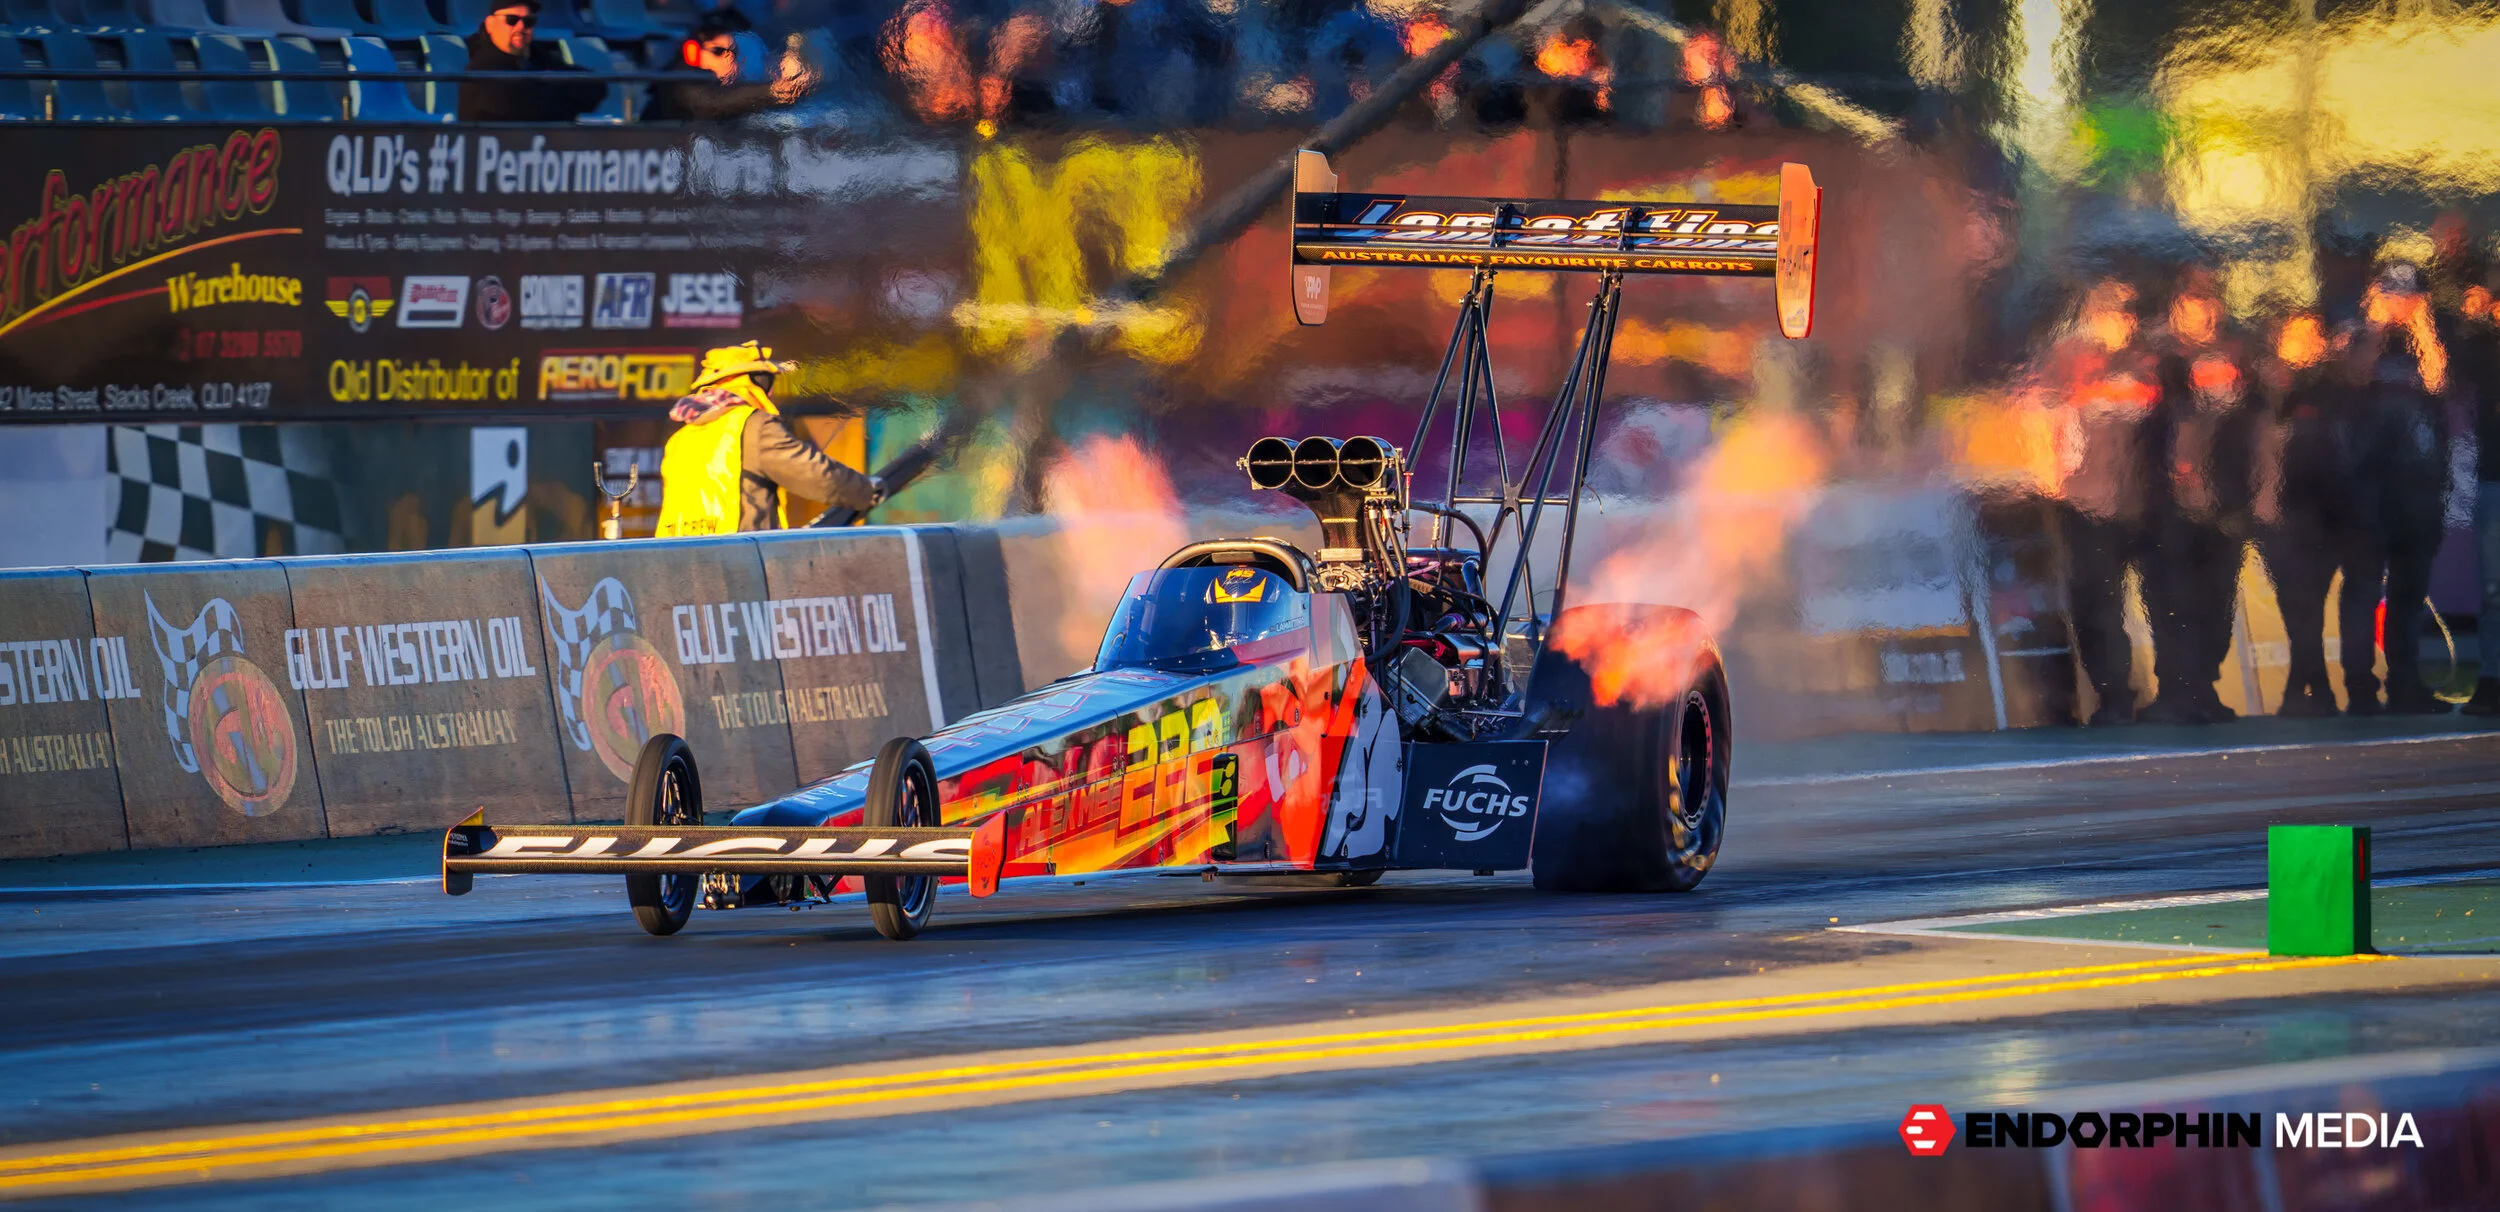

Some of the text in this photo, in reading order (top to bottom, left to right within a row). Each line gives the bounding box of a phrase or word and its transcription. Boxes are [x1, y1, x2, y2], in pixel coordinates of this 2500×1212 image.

[327, 134, 420, 196] QLD's
[428, 134, 465, 194] #1
[476, 134, 682, 194] Performance
[1322, 251, 1754, 272] AUSTRALIA'S FAVOURITE CARROTS
[167, 262, 302, 313] Warehouse
[598, 275, 651, 319] AFR
[662, 273, 744, 315] JESEL
[203, 382, 235, 409] QLD
[329, 357, 521, 403] Qld Distributor of
[672, 593, 906, 665] GULF WESTERN OIL
[89, 636, 141, 700] OIL
[284, 616, 536, 690] GULF WESTERN OIL
[711, 694, 744, 729] THE
[325, 718, 360, 755] THE
[1423, 788, 1529, 817] FUCHS
